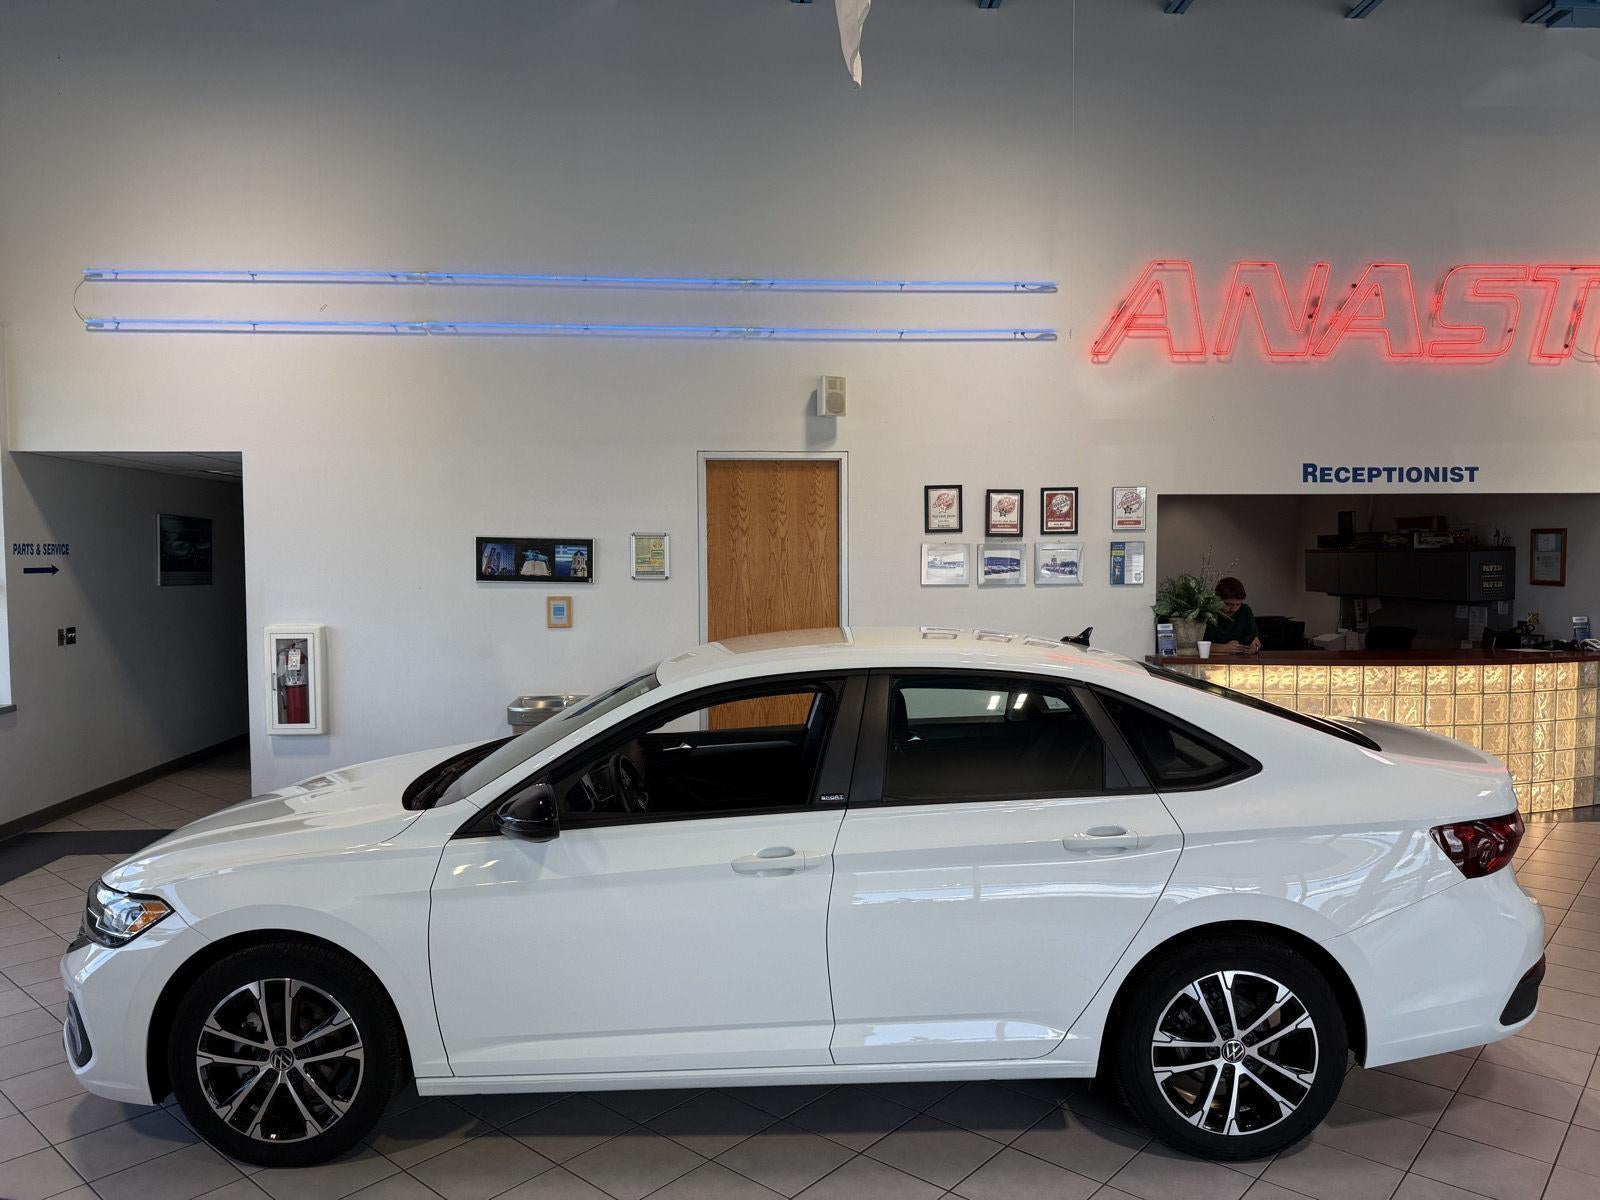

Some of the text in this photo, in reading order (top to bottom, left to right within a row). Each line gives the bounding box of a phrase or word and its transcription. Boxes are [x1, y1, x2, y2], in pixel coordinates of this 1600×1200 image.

[1301, 463, 1480, 484] RECEPTIONIST
[12, 543, 70, 556] PARTS & SERVICE
